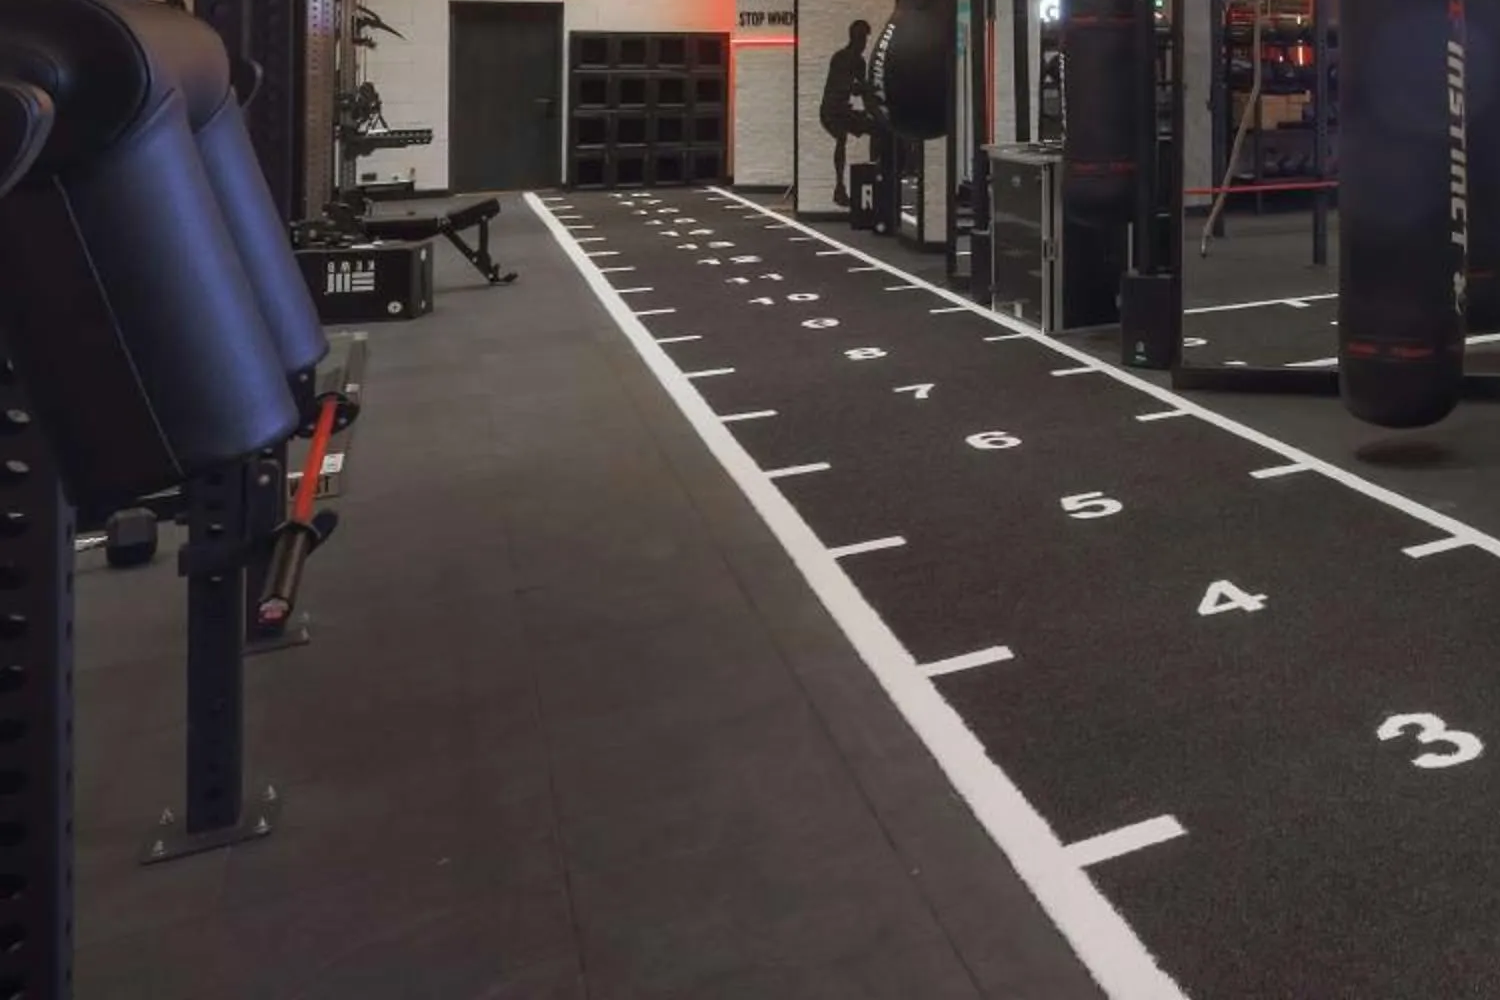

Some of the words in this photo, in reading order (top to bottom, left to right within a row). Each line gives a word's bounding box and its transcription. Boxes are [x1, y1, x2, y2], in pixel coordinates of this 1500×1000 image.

[739, 11, 764, 27] STOP
[749, 293, 820, 305] 10
[844, 347, 888, 361] 8
[893, 383, 936, 399] 7
[966, 431, 1022, 449] 6
[1060, 491, 1123, 518] 5
[1198, 579, 1268, 615] 4
[1377, 712, 1484, 768] 3
